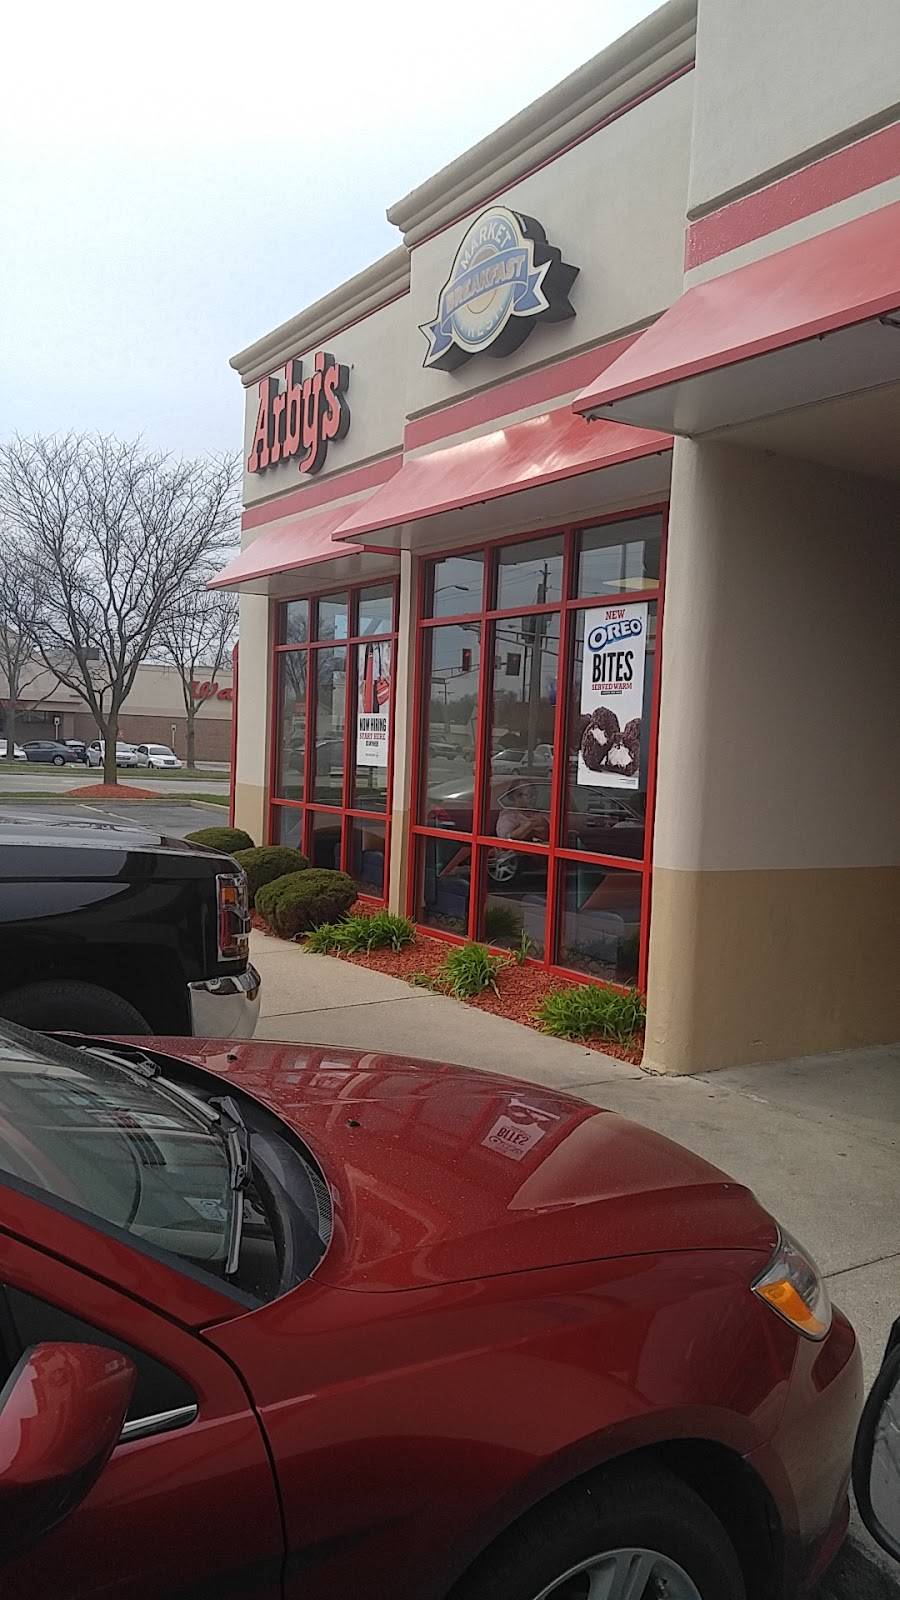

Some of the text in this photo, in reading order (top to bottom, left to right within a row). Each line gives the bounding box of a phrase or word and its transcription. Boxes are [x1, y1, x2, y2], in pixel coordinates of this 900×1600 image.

[460, 222, 513, 270] MARKET
[445, 254, 527, 314] BREAKFAST
[247, 351, 345, 474] Arby's
[605, 608, 626, 621] NEW
[588, 618, 643, 652] OREO
[592, 650, 634, 683] BITES
[591, 682, 633, 691] SERVED WARM
[359, 717, 387, 732] NOW HIRING
